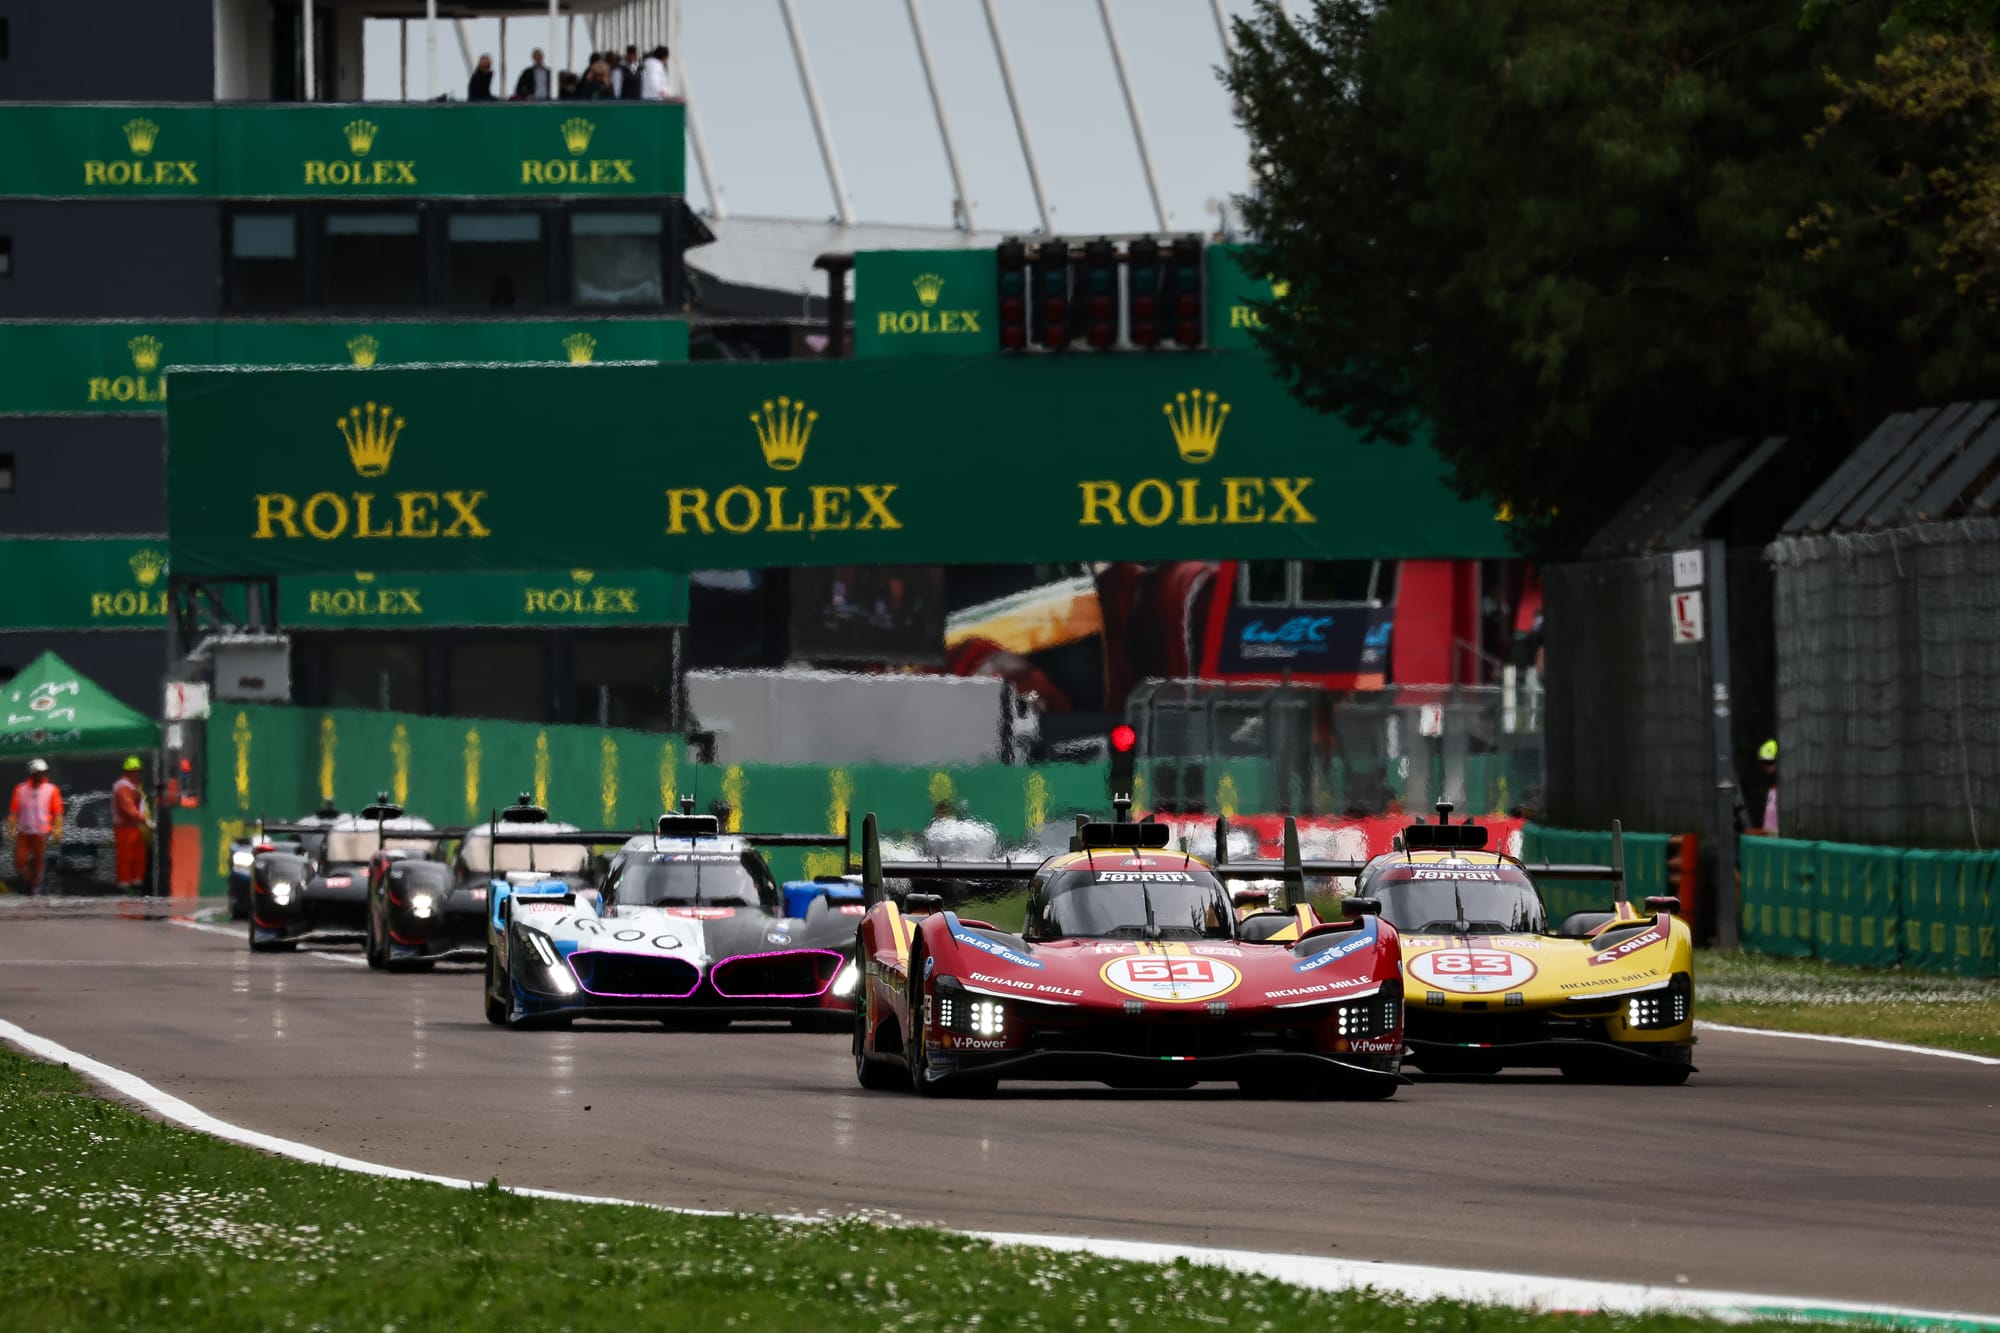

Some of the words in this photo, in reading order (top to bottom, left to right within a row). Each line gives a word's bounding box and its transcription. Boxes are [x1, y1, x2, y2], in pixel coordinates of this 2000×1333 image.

[85, 162, 196, 184] ROLEX
[305, 162, 416, 184] ROLEX
[522, 161, 633, 183] ROLEX
[879, 311, 980, 333] ROLEX
[666, 484, 902, 534] ROLEX
[1079, 477, 1316, 527] ROLEX
[254, 490, 490, 540] ROLEX
[310, 591, 421, 613] ROLEX
[526, 590, 635, 612] ROLEX
[1096, 872, 1194, 882] Ferrari
[1410, 870, 1502, 881] Ferrari
[954, 934, 991, 950] ADLER
[1002, 952, 1040, 968] GROUP
[1300, 954, 1333, 971] ADLER
[1342, 936, 1374, 952] GROUP
[1619, 932, 1661, 953] ORLEN
[1131, 962, 1209, 980] 51
[1437, 955, 1508, 972] 83
[970, 972, 1035, 990] RICHARD
[1036, 984, 1084, 997] MILLE
[1264, 985, 1328, 998] RICHARD
[1329, 975, 1372, 990] MILLE
[1560, 978, 1619, 990] RICHARD
[1622, 968, 1660, 982] MILLE
[953, 1037, 1006, 1049] V-Power
[1350, 1041, 1394, 1052] V-Power
